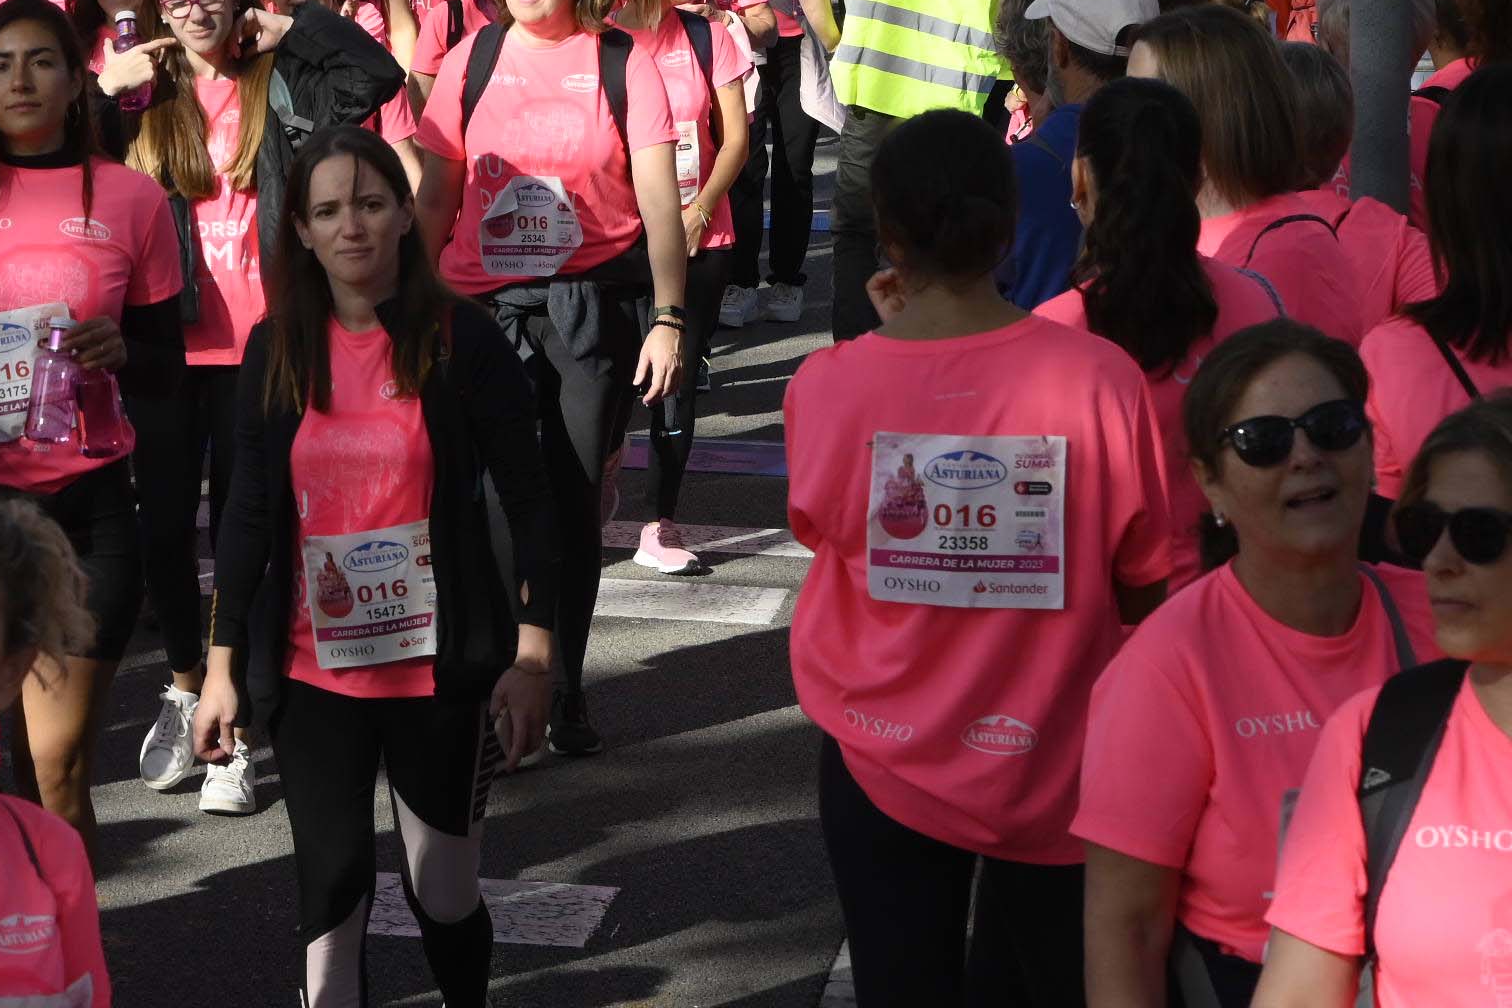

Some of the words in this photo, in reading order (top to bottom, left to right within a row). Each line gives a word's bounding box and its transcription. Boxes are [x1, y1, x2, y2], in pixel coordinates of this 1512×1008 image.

[61, 223, 108, 238] ASTURIANA
[517, 215, 548, 230] 016
[491, 260, 524, 269] OYSHO
[10, 402, 22, 412] LA
[929, 464, 1001, 480] ASTURIANA
[1014, 458, 1051, 470] SUMA
[933, 503, 997, 528] 016
[938, 535, 989, 551] 23358
[349, 551, 405, 568] ASTURIANA
[889, 554, 941, 567] CARRERA
[943, 558, 958, 567] DE
[960, 559, 974, 568] LA
[977, 560, 1015, 569] MUJER
[1018, 561, 1044, 569] 2023
[356, 579, 408, 604] 016
[883, 576, 941, 593] OYSHO
[989, 582, 1049, 595] Santander
[366, 604, 406, 620] 15473
[331, 627, 370, 638] CARRERA
[372, 625, 384, 634] DE
[386, 623, 397, 632] LA
[399, 616, 428, 629] MUJER
[330, 645, 376, 659] OYSHO
[843, 708, 914, 743] OYSHO
[966, 729, 1035, 749] ASTURIANA
